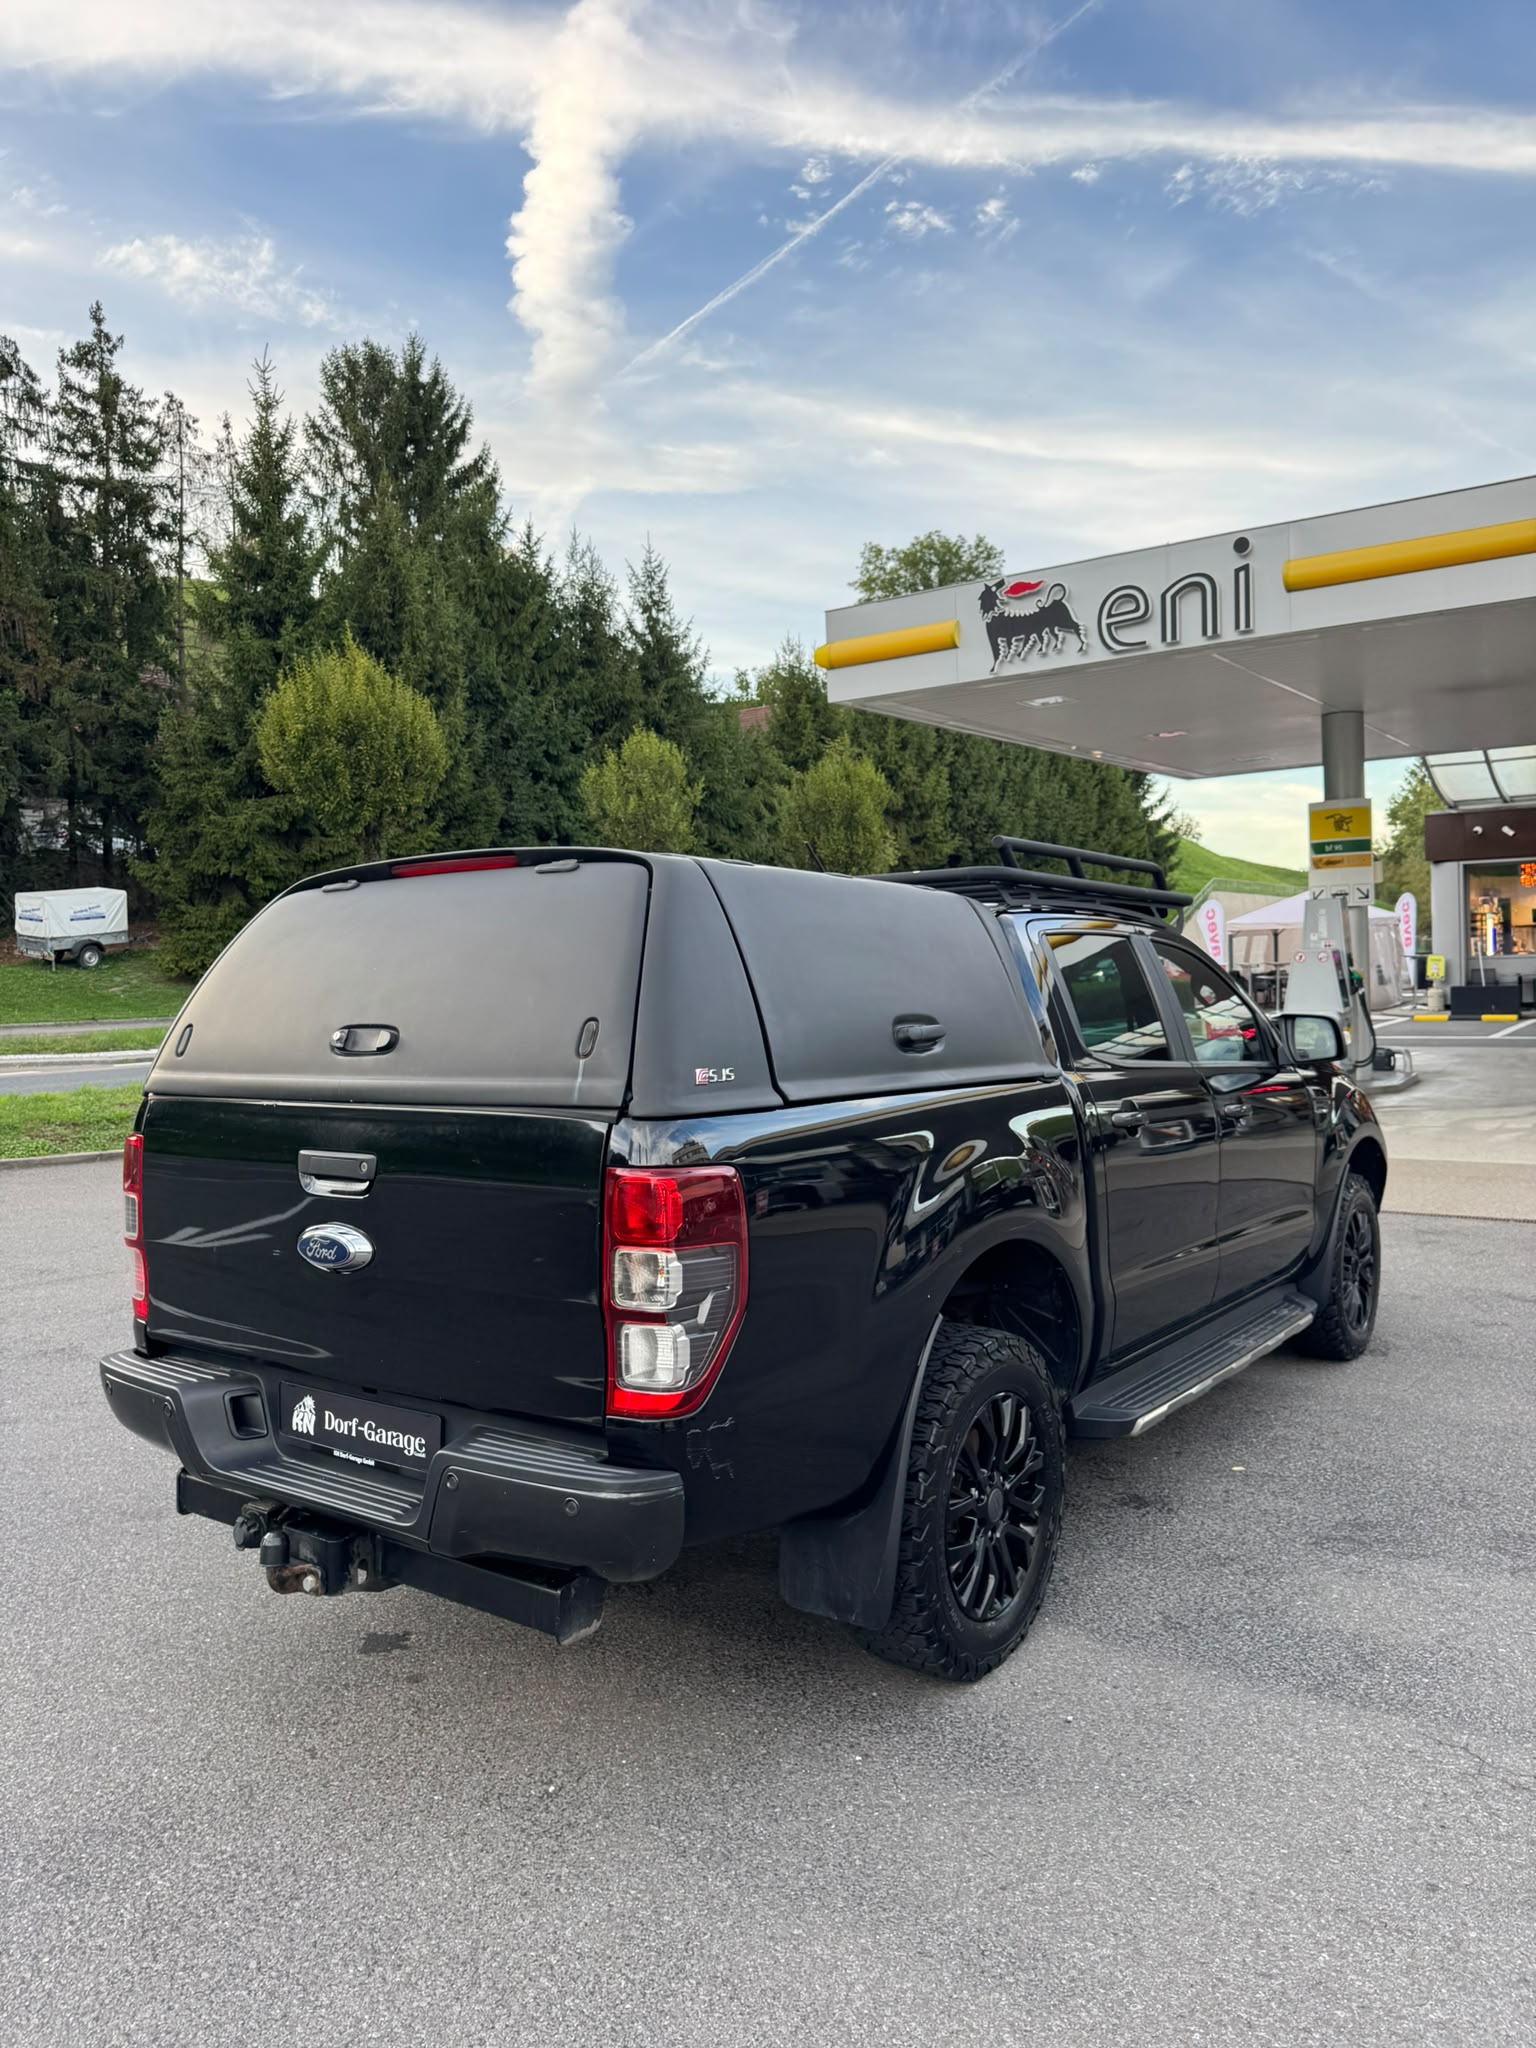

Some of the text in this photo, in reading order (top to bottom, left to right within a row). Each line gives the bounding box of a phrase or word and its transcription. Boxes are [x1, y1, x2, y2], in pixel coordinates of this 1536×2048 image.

[1097, 536, 1253, 651] eni
[306, 1237, 338, 1260] Ford
[324, 1410, 426, 1456] Dorf-Garage
